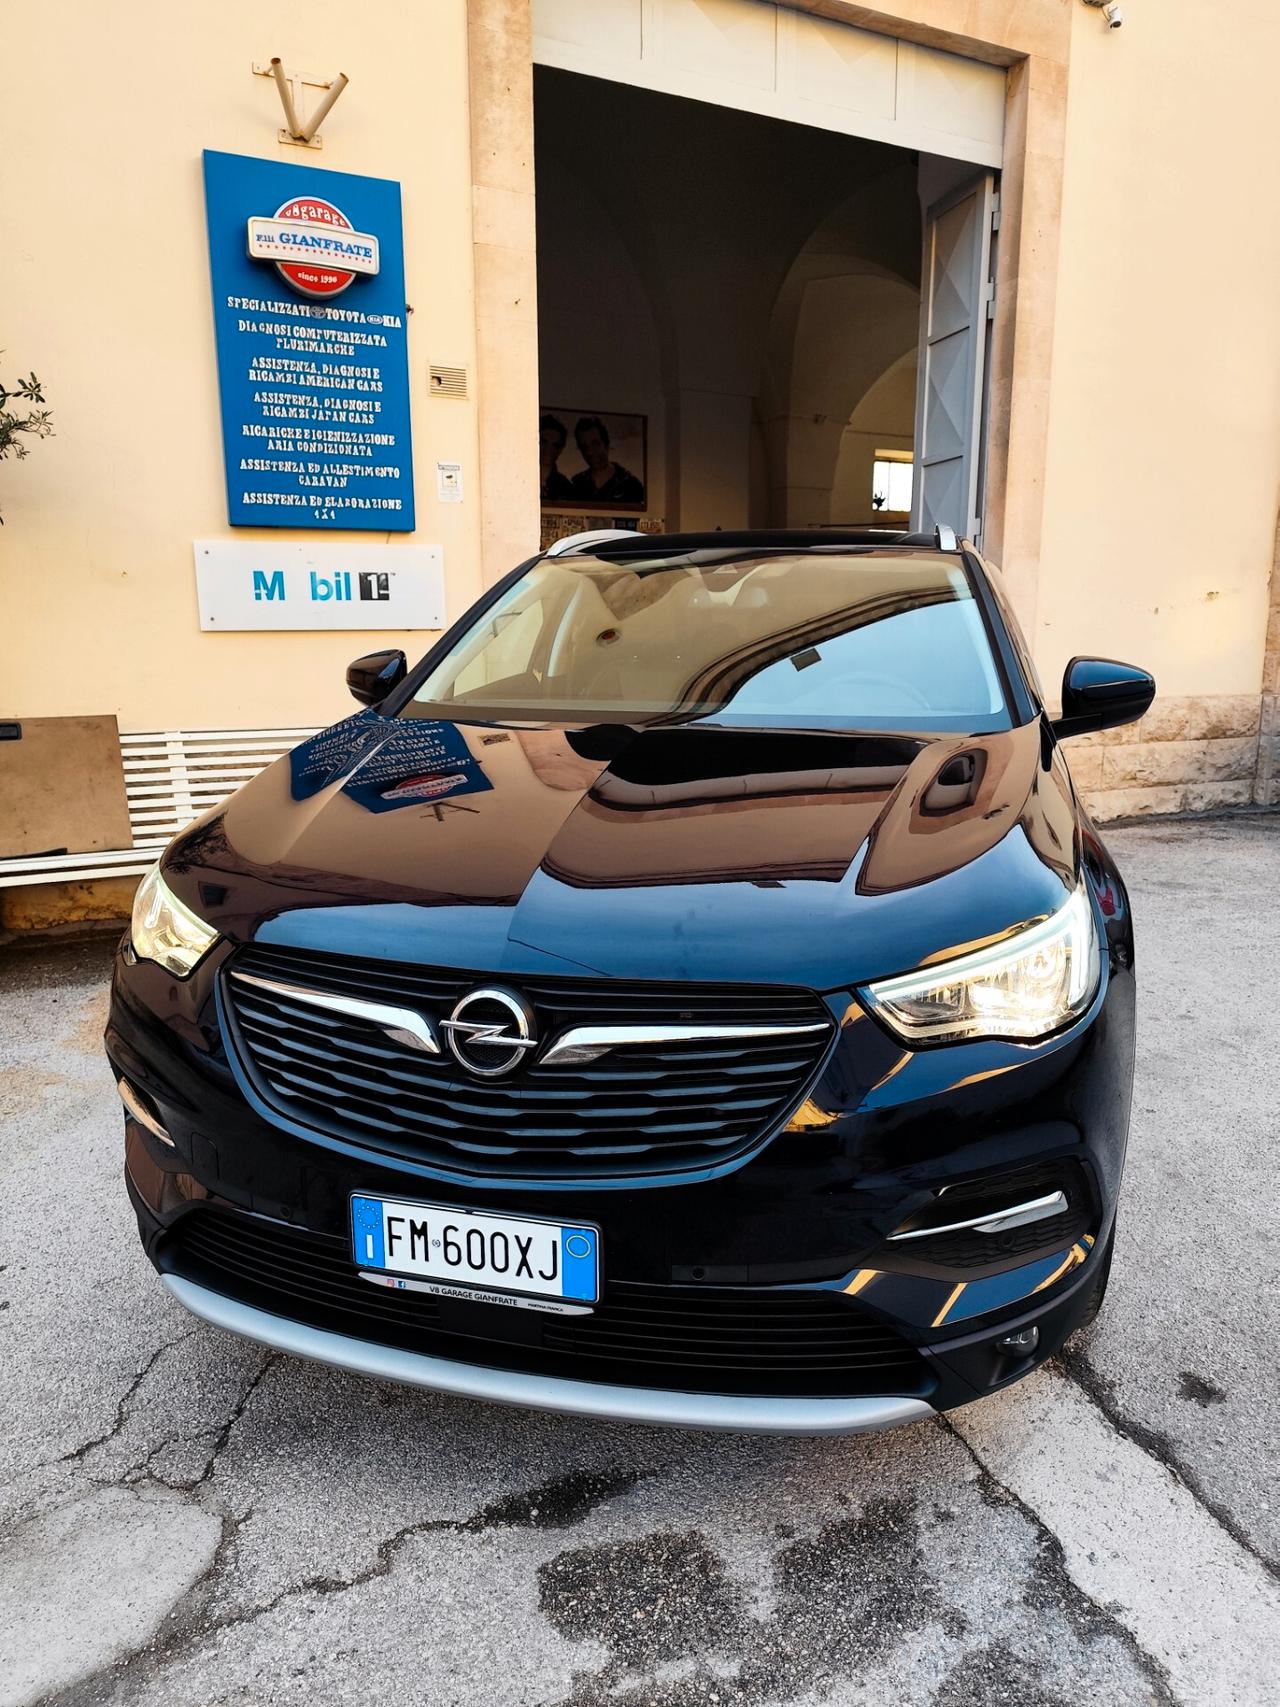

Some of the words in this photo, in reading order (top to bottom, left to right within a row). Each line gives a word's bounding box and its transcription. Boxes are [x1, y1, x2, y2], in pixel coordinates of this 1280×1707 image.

[279, 232, 373, 258] GIANFRATE
[297, 271, 319, 283] since
[227, 296, 311, 318] SPECIALIZZATI
[325, 307, 367, 324] TOYOTA
[382, 315, 402, 328] KIA
[238, 319, 291, 336] DIAGNOSI
[293, 326, 388, 347] COMPUTERIZZATA
[276, 338, 355, 356] PLURIMARCHE
[252, 356, 321, 375] ASSISTENZA,
[322, 363, 372, 379] DIAGNOSI
[373, 368, 380, 379] E
[248, 369, 297, 384] RICAMBI
[298, 372, 356, 390] AMERICAN
[356, 379, 384, 392] CARS
[254, 391, 323, 409] ASSISTENZA,
[323, 397, 374, 412] DIAGNOSI
[374, 401, 382, 412] E
[262, 405, 310, 420] RICAMBI
[311, 408, 347, 422] JAPAN
[348, 412, 375, 425] CARS
[242, 425, 303, 439] RICARICHE
[303, 428, 311, 439] E
[311, 429, 395, 446] IGIENIZZAZIONE
[267, 439, 295, 451] ARIA
[297, 441, 373, 457] CONDIZIONATA
[240, 458, 306, 473] ASSISTENZA
[307, 462, 320, 474] ED
[322, 464, 400, 479] ALLESTIMENTO
[298, 475, 348, 488] CARAVAN
[242, 492, 308, 506] ASSISTENZA
[309, 495, 322, 506] ED
[324, 496, 402, 510] ELABORAZIONE
[429, 1286, 440, 1294] V8
[441, 1288, 473, 1299] GARAGE
[474, 1293, 518, 1306] GIANFRATE
